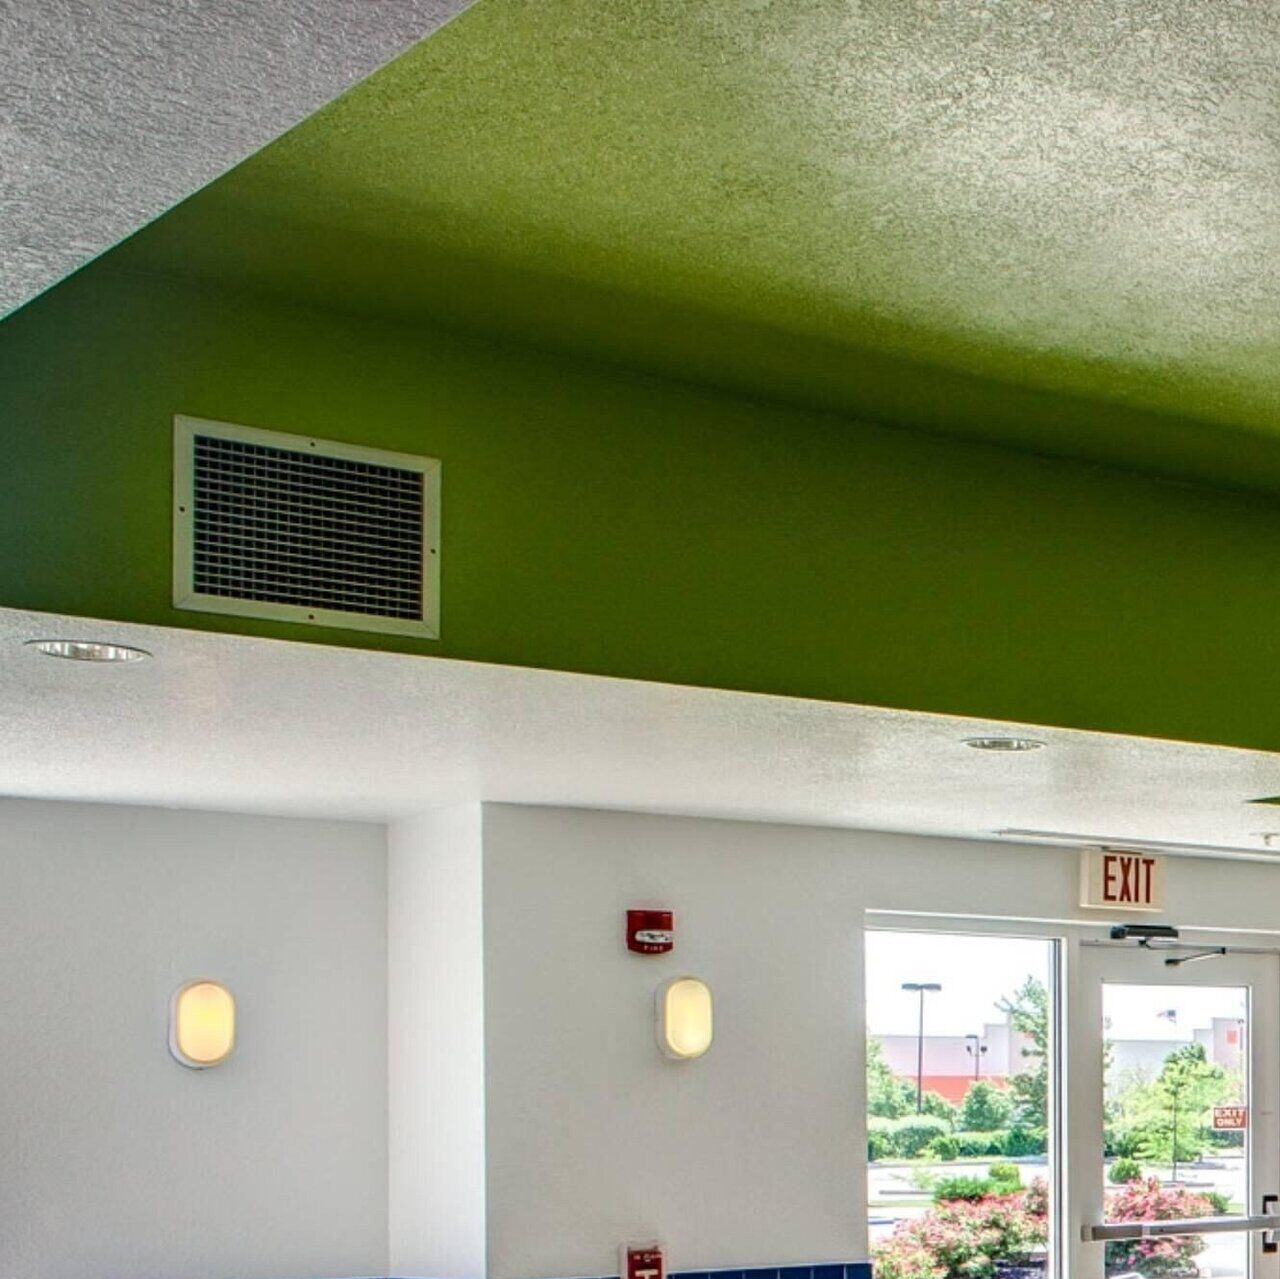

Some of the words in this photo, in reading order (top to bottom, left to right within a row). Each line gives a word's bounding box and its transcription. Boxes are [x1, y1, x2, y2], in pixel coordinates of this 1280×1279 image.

[1103, 856, 1155, 903] EXIT
[1215, 1108, 1245, 1118] EXIT
[1216, 1118, 1243, 1128] ONLY
